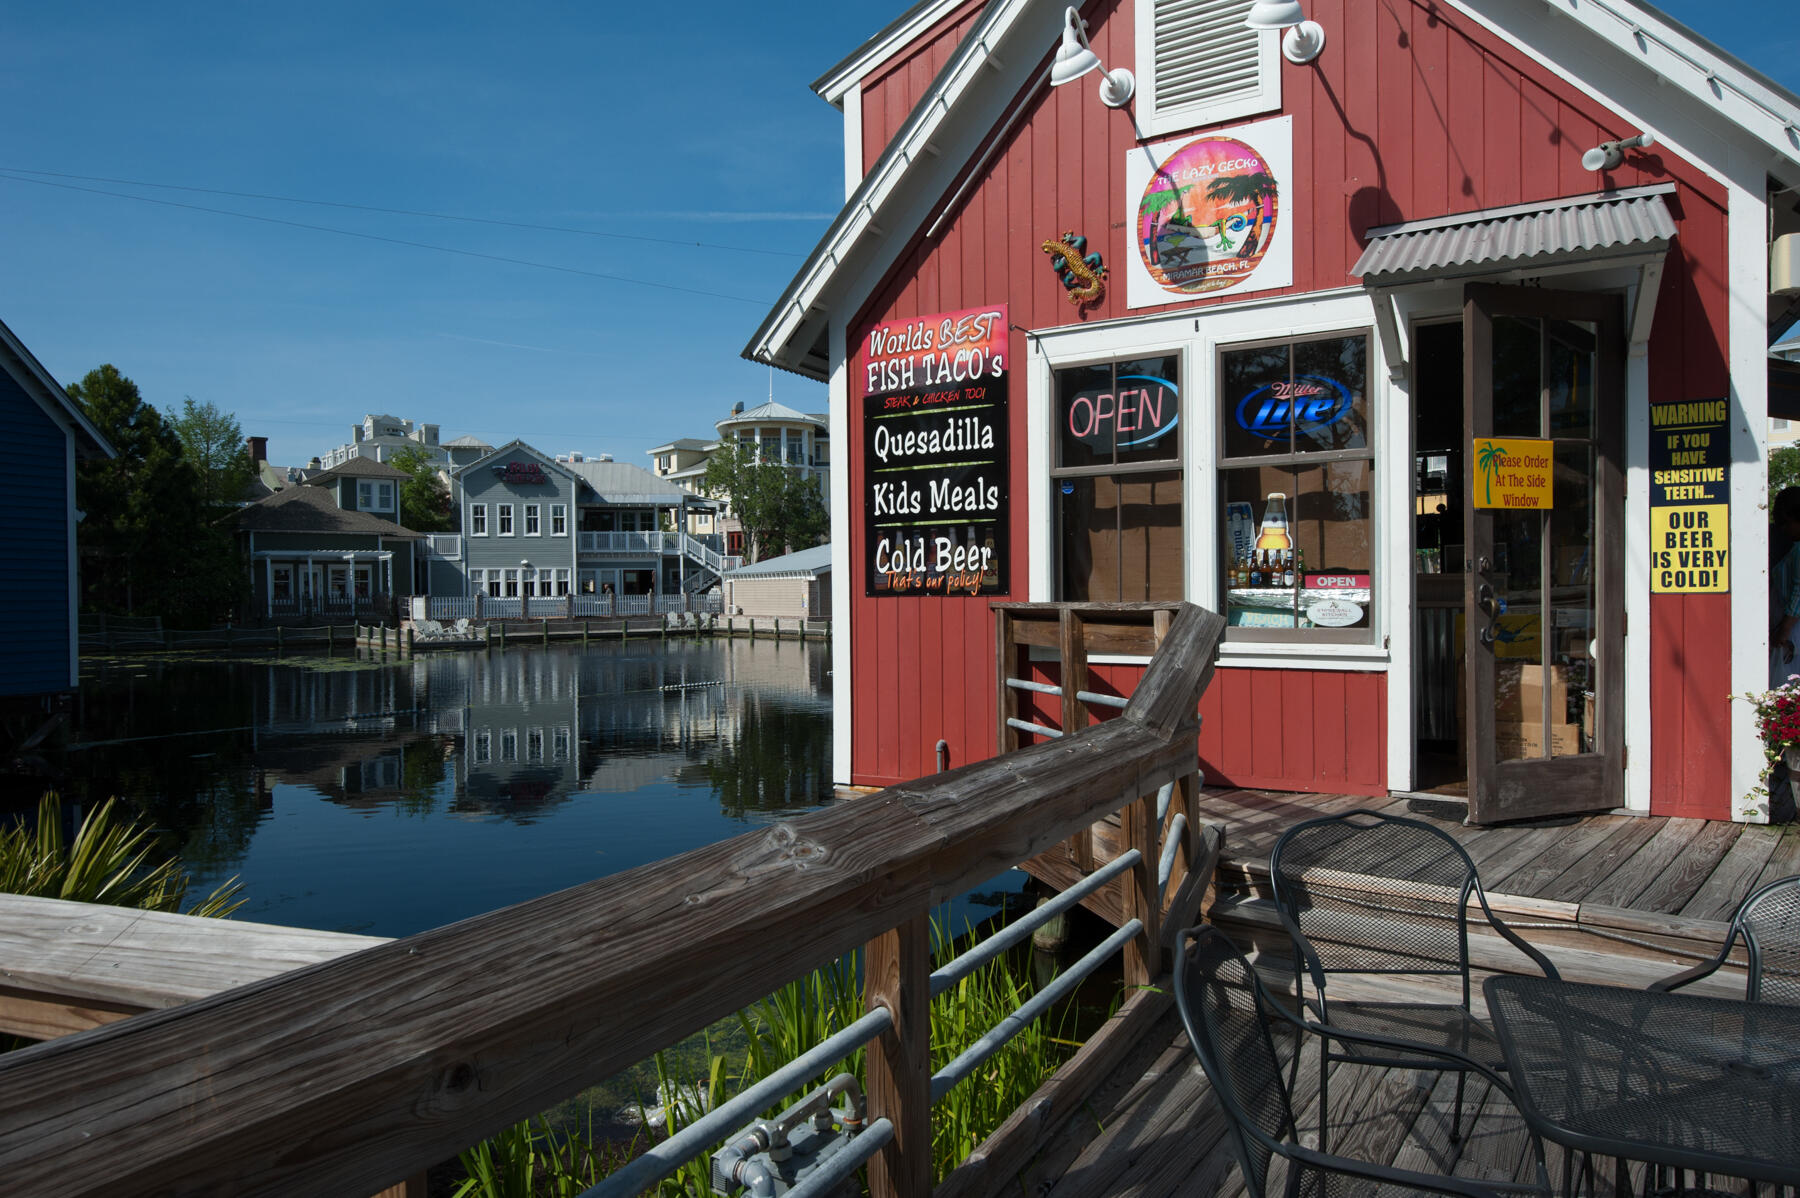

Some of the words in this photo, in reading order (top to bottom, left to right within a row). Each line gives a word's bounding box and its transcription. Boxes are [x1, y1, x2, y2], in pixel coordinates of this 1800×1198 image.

[1157, 170, 1179, 185] THE
[1182, 163, 1215, 180] LAZY
[1217, 158, 1258, 173] GECKO
[1162, 267, 1204, 281] MIRAMAR
[1239, 259, 1250, 270] FL
[869, 321, 934, 357] Worlds
[937, 311, 1002, 350] BEST
[867, 355, 915, 393] FISH
[922, 346, 1003, 386] TACO's
[883, 396, 912, 409] STEAK
[922, 390, 961, 405] CHICKEN
[1270, 381, 1323, 401] Miller
[1068, 386, 1163, 438] OPEN
[1251, 398, 1335, 430] Lite
[1651, 400, 1727, 427] WARNING
[874, 416, 995, 463] Quesadilla
[1667, 435, 1680, 450] IF
[1682, 432, 1710, 448] YOU
[1492, 453, 1522, 468] Please
[1523, 454, 1549, 469] Order
[1671, 450, 1707, 466] HAVE
[1495, 474, 1506, 488] At
[1508, 474, 1525, 488] The
[1526, 474, 1547, 488] Side
[1654, 466, 1725, 485] SENSITIVE
[873, 480, 921, 517] Kids
[929, 476, 999, 514] Meals
[1502, 493, 1540, 508] Window
[1663, 484, 1715, 501] TEETH...
[1669, 511, 1709, 530] OUR
[1665, 530, 1713, 549] BEER
[876, 537, 927, 574] Cold
[934, 536, 992, 573] Beer
[1652, 551, 1672, 569] IS
[1677, 549, 1727, 568] VERY
[885, 567, 922, 590] That's
[925, 574, 945, 588] our
[946, 565, 985, 597] policy!
[1316, 576, 1356, 587] OPEN
[1660, 569, 1719, 588] COLD!
